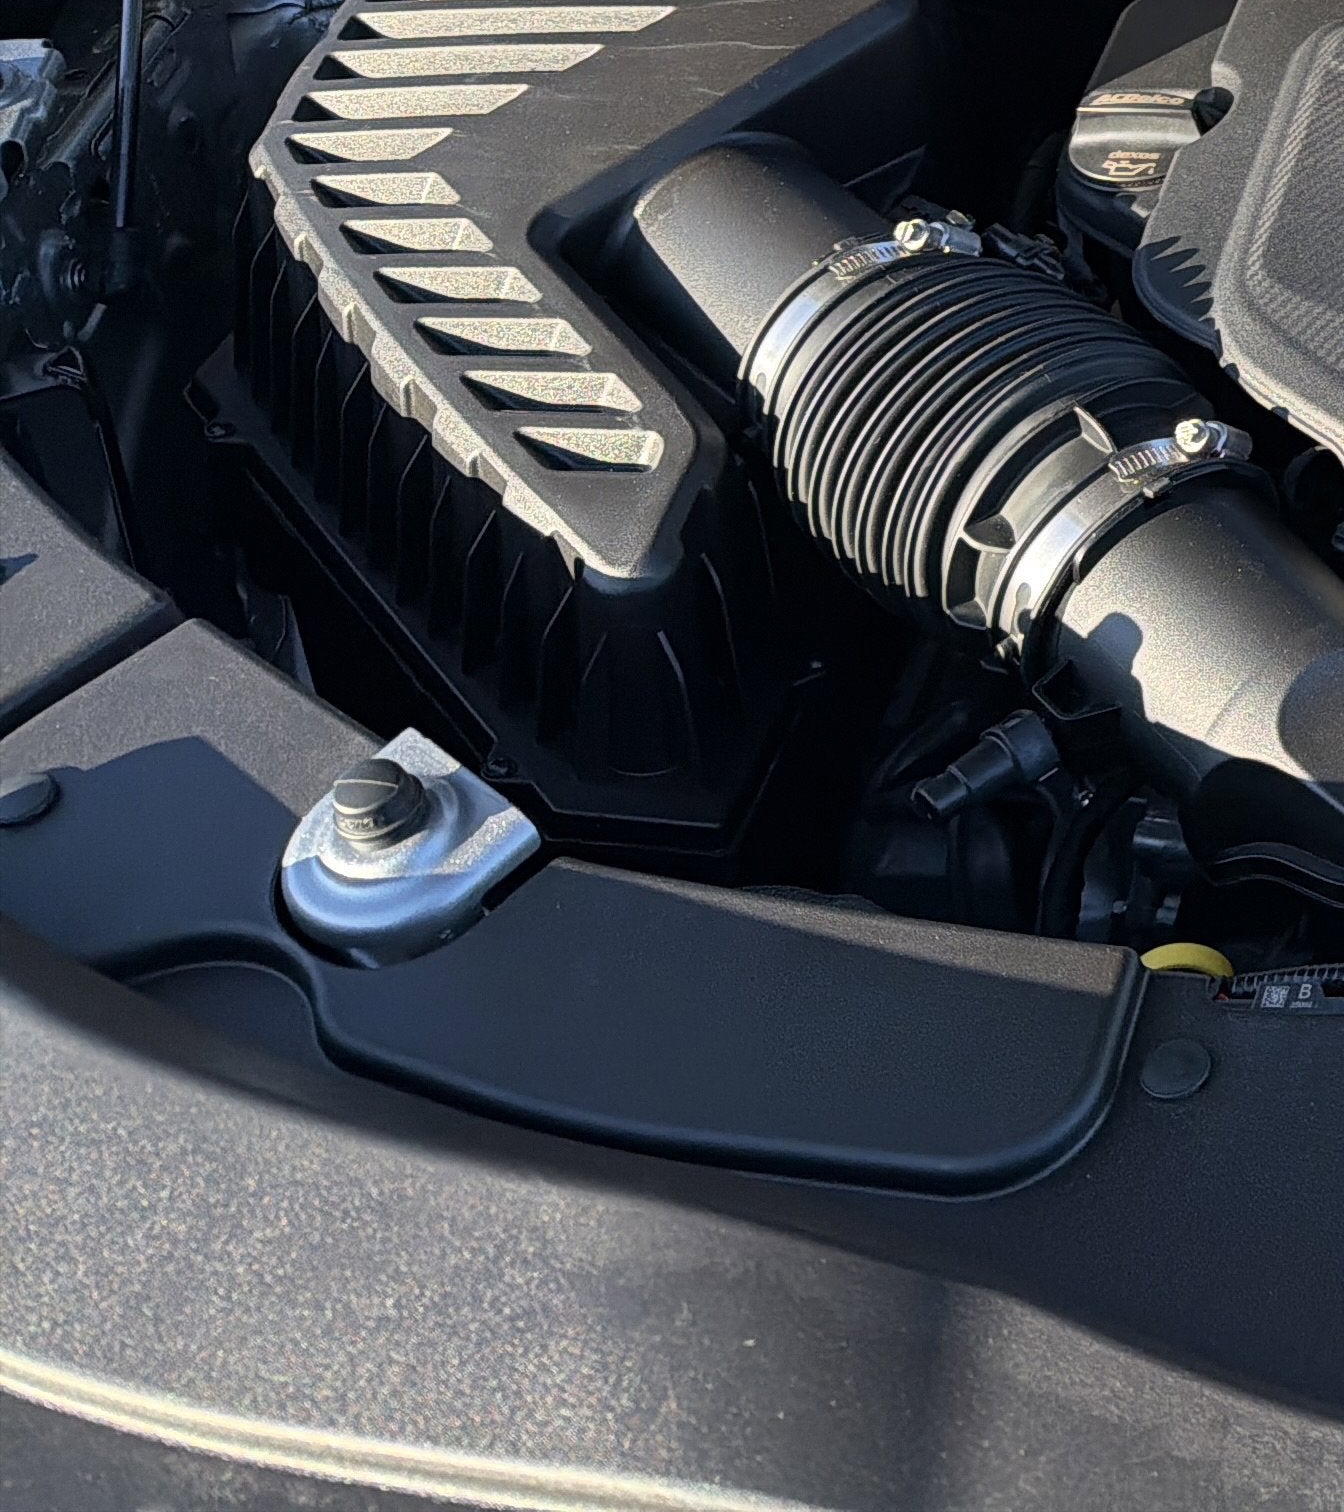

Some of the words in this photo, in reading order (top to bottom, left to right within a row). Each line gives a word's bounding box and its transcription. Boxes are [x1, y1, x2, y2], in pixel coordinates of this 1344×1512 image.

[1090, 93, 1185, 106] ACDelco
[1108, 150, 1162, 160] dexos
[1298, 983, 1313, 999] B
